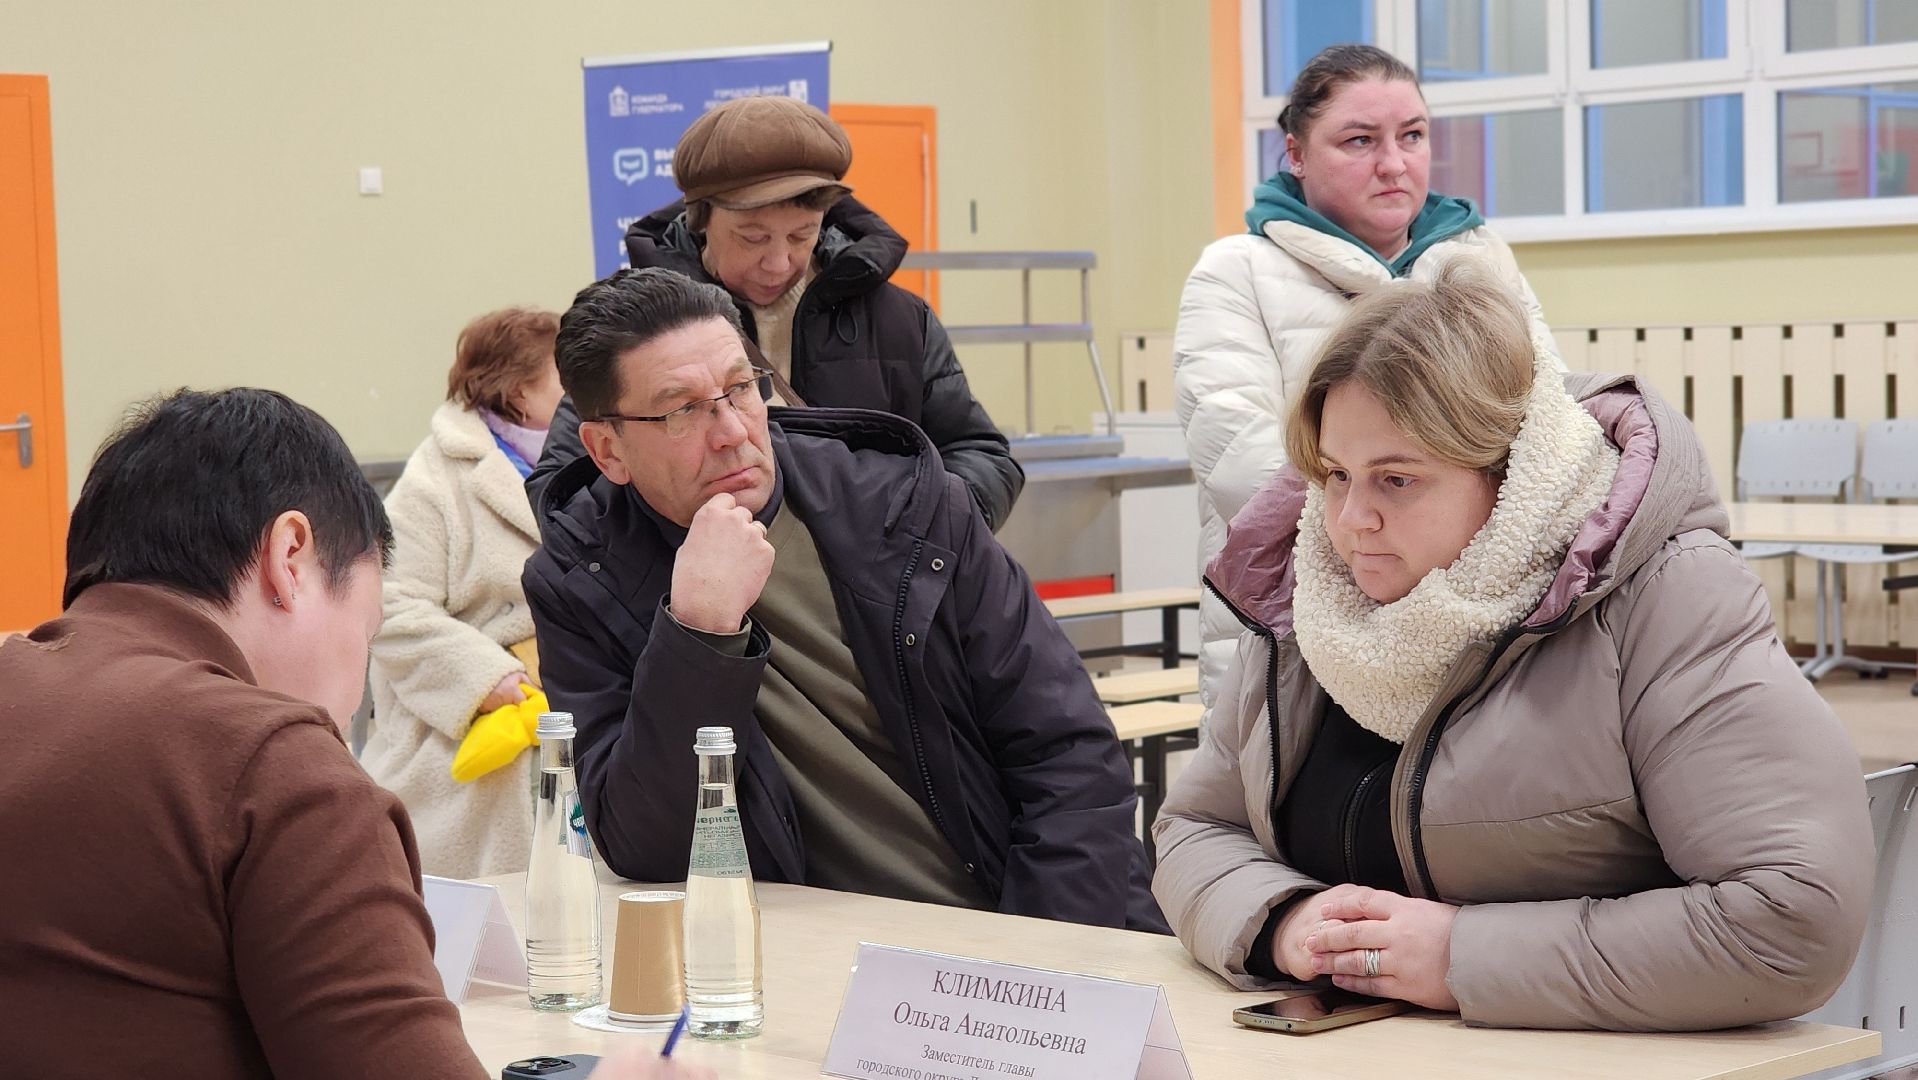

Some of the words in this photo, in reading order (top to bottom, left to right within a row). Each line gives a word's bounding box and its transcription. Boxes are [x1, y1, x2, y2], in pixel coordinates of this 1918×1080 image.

[931, 970, 1067, 1013] КЛИМКИНА
[894, 1001, 951, 1032] Ольга
[954, 1012, 1087, 1055] Анатольевна
[856, 1059, 922, 1080] городского
[921, 1044, 995, 1071] Заместитель
[998, 1062, 1036, 1078] главы
